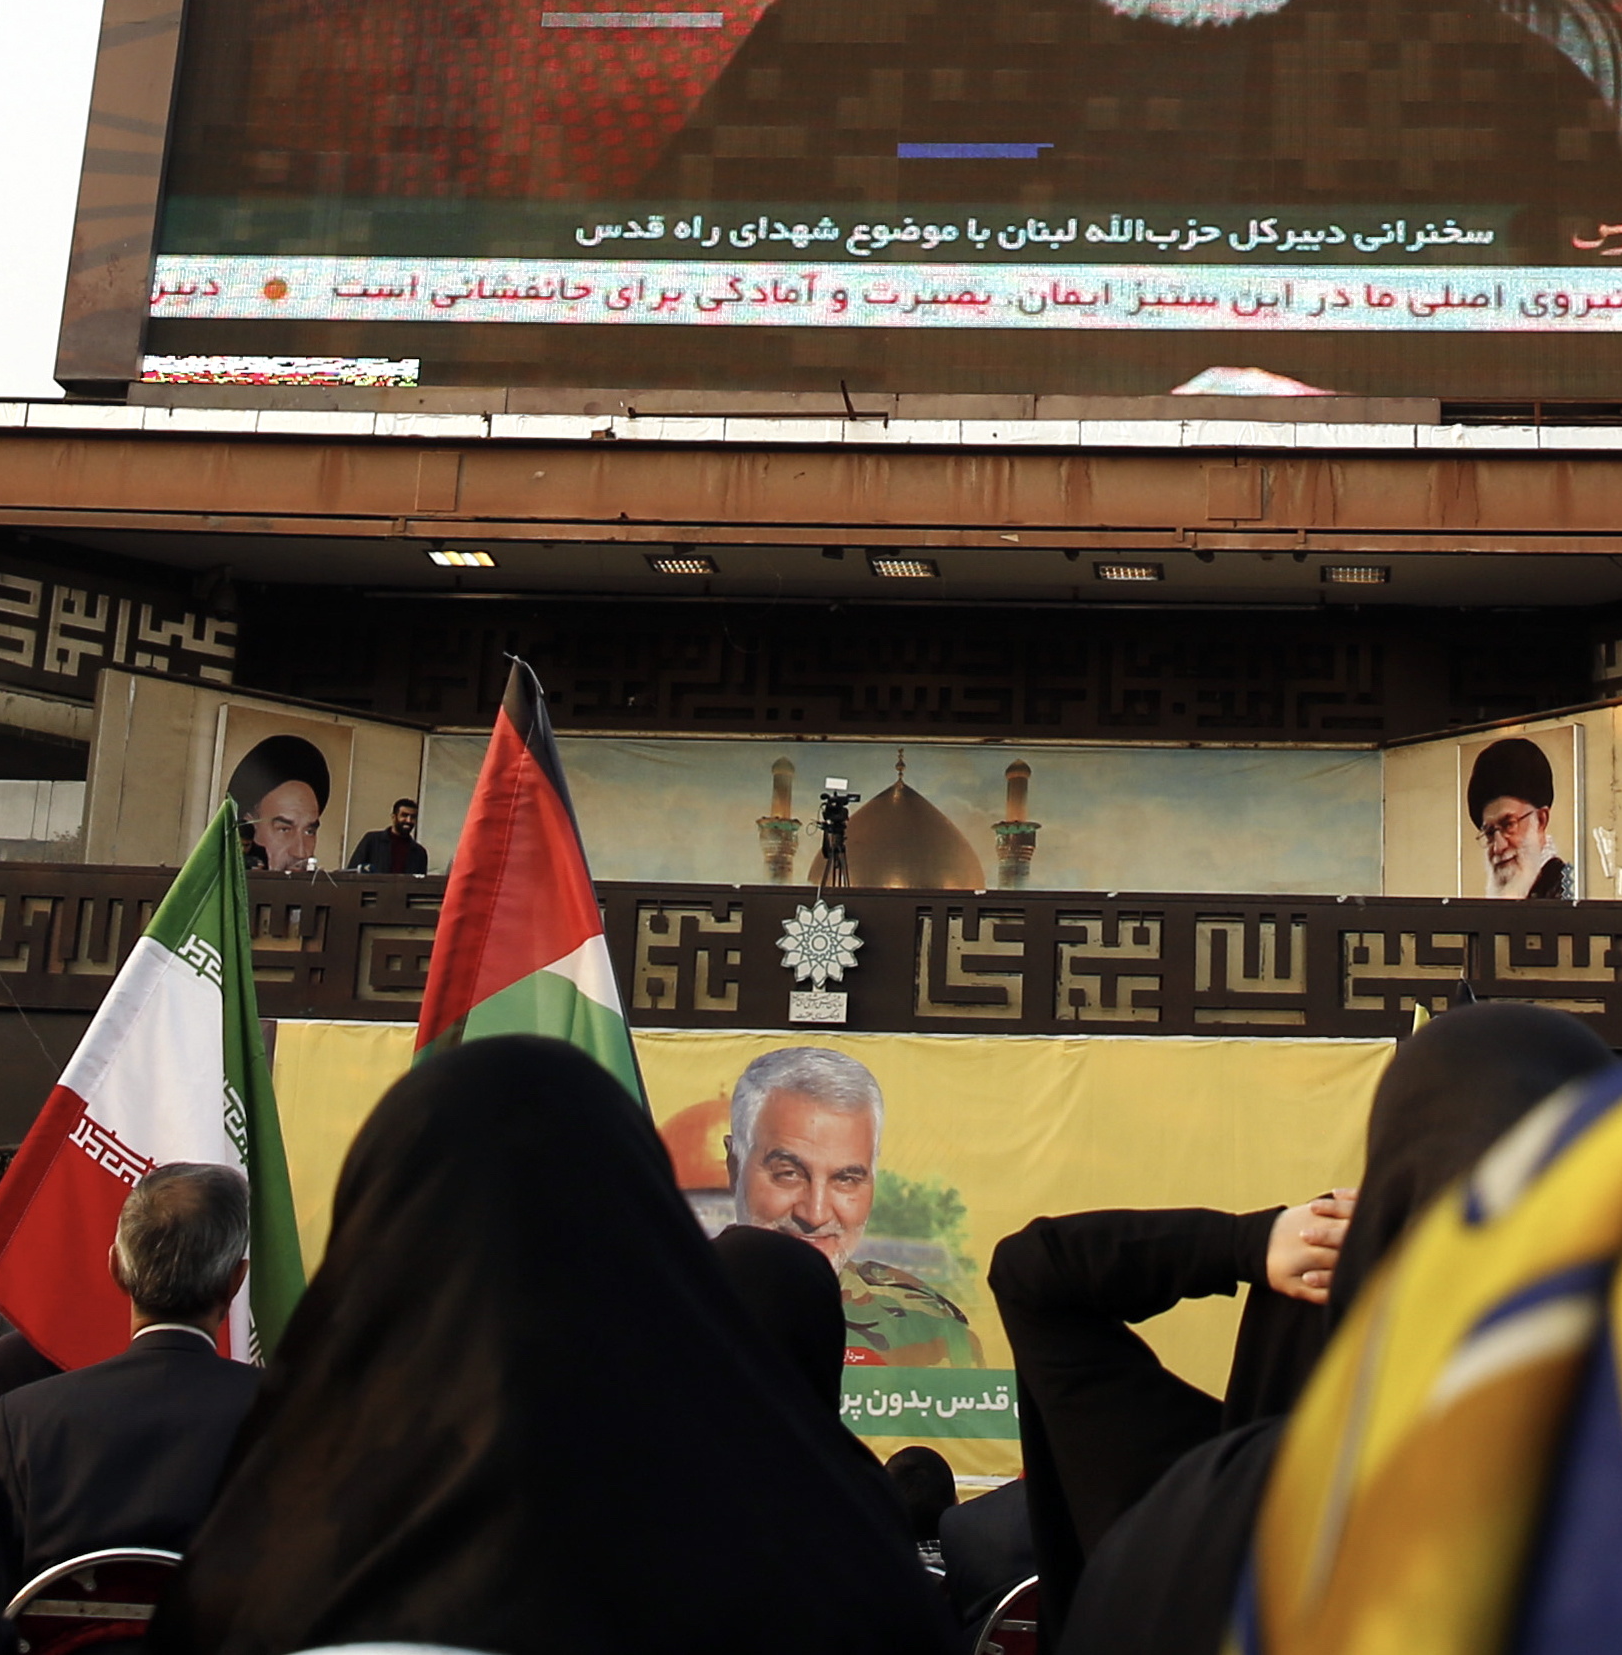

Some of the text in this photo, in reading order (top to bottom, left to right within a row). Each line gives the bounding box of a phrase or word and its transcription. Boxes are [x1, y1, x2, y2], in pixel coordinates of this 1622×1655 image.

[576, 215, 665, 247] قدس
[673, 215, 721, 247] راه
[729, 217, 840, 249] شهدای
[846, 218, 959, 256] موضوع
[967, 218, 991, 250] با
[997, 218, 1077, 250] لبنان
[1229, 217, 1347, 251] دبیرکل
[1353, 219, 1494, 252] سخنرانی
[333, 274, 418, 298] است
[606, 279, 683, 312] برای
[832, 288, 849, 313] و
[1232, 284, 1293, 317] این
[1364, 284, 1395, 308] ما
[1407, 285, 1502, 318] اصلی
[1308, 288, 1351, 317] در
[866, 1388, 932, 1418] بدون
[936, 1385, 1009, 1418] قدس
